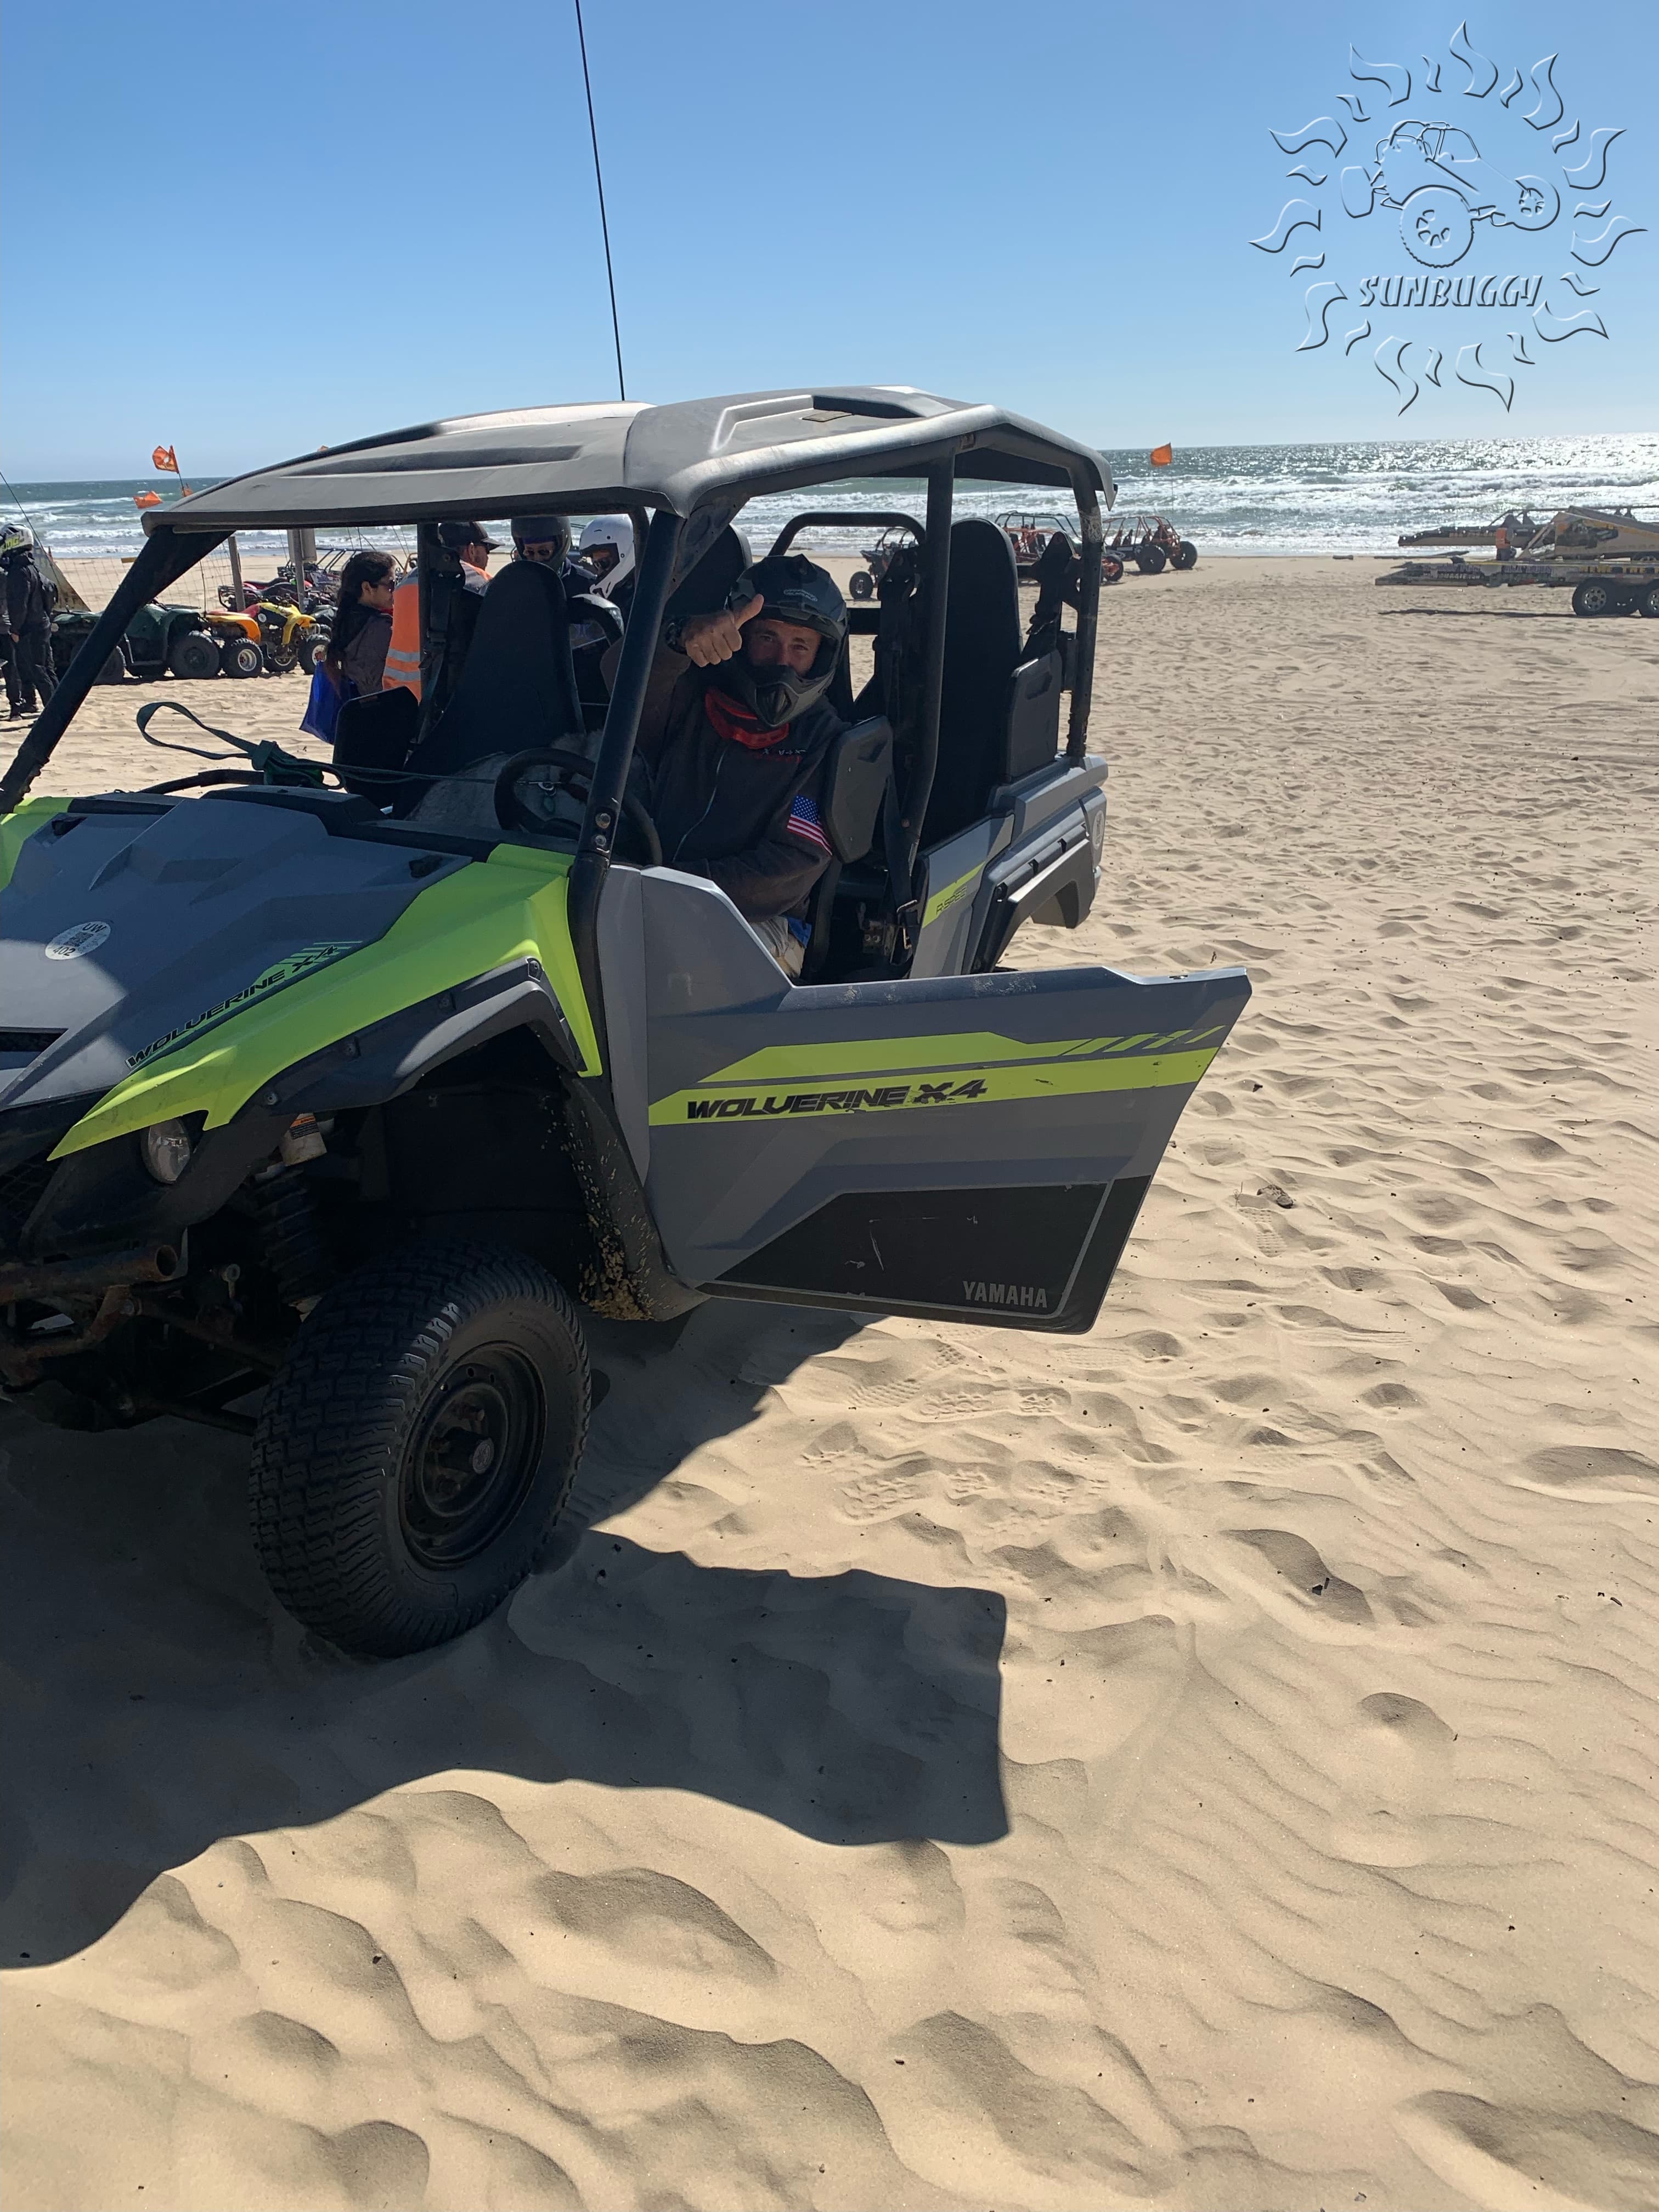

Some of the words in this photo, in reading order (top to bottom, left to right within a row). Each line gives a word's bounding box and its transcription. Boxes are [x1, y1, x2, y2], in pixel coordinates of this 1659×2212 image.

[82, 923, 107, 933] UW
[52, 946, 76, 956] 402
[125, 969, 286, 1069] WOLVERINE
[291, 945, 338, 973] X4
[687, 1086, 911, 1119] WOLVERINE
[912, 1079, 988, 1104] X4
[962, 1280, 1047, 1308] YAMAHA
